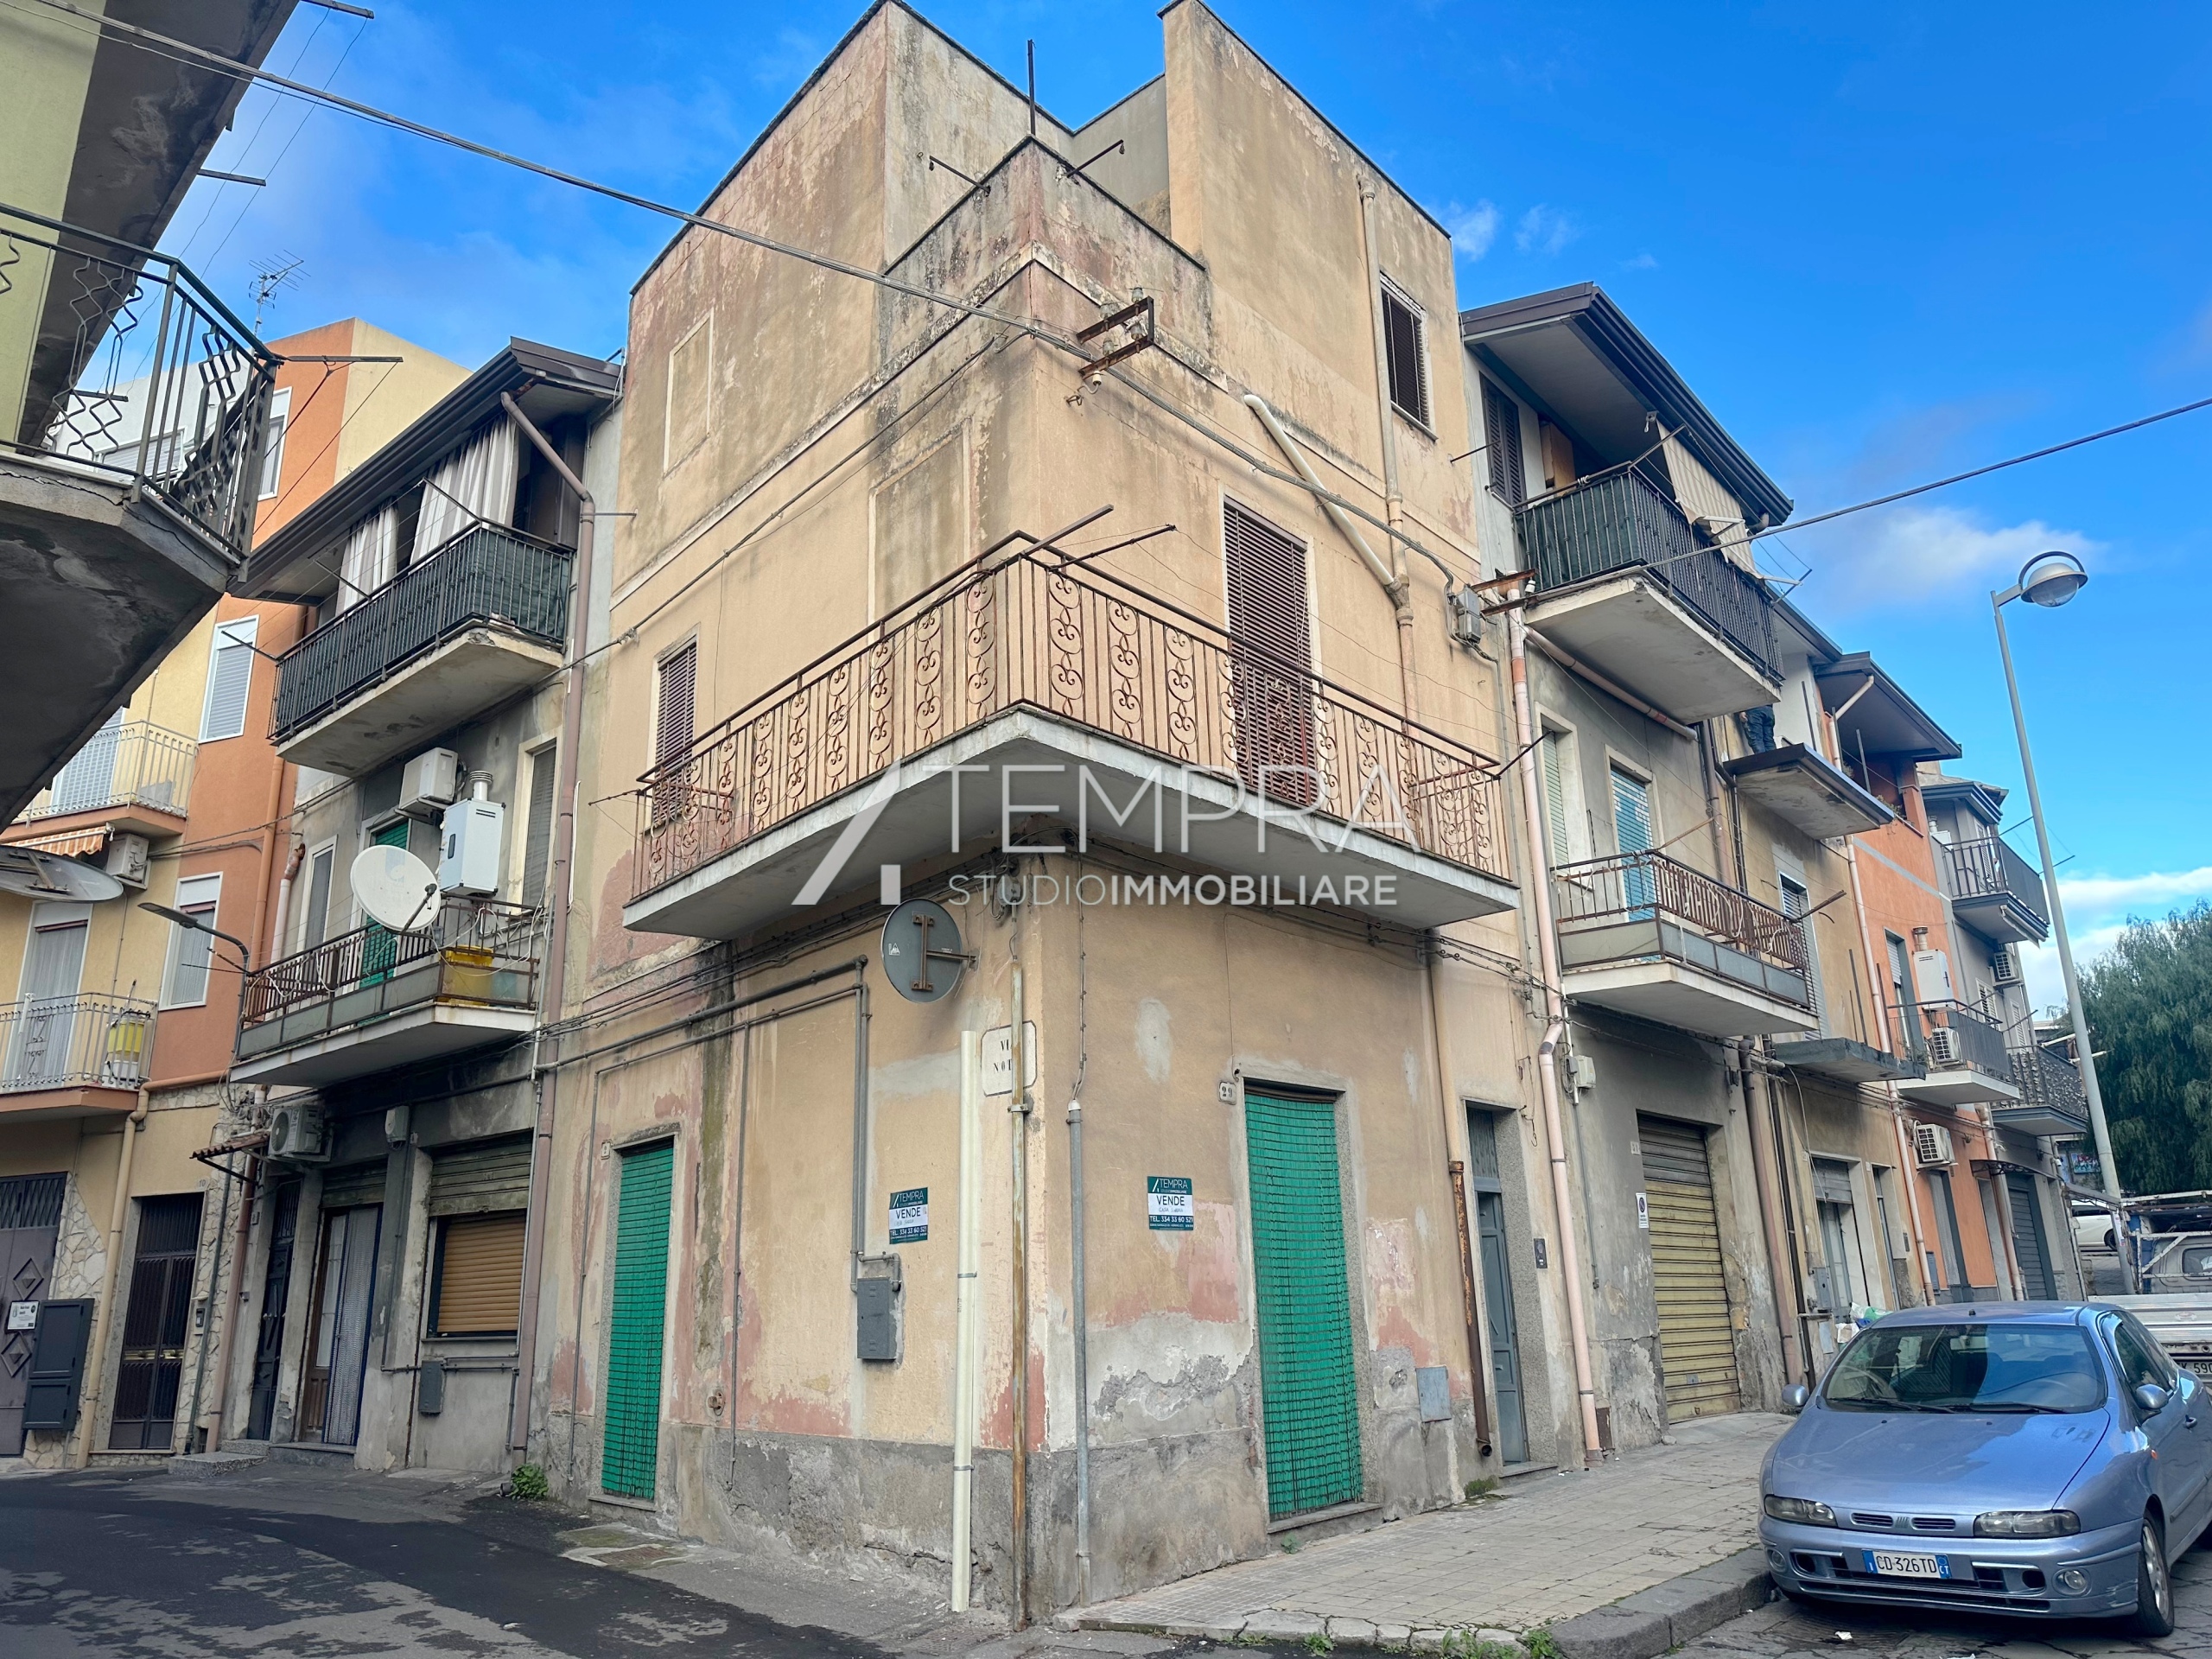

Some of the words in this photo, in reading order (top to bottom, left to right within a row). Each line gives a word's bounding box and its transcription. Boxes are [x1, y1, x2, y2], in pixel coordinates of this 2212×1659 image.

[1001, 1039, 1012, 1051] VI
[1222, 1086, 1233, 1097] 29
[1159, 1178, 1188, 1189] TEMPRA
[899, 1191, 924, 1202] TEMPRA
[1156, 1195, 1185, 1205] VENDE
[896, 1207, 921, 1219] VENDE
[1939, 1565, 1949, 1574] CT
